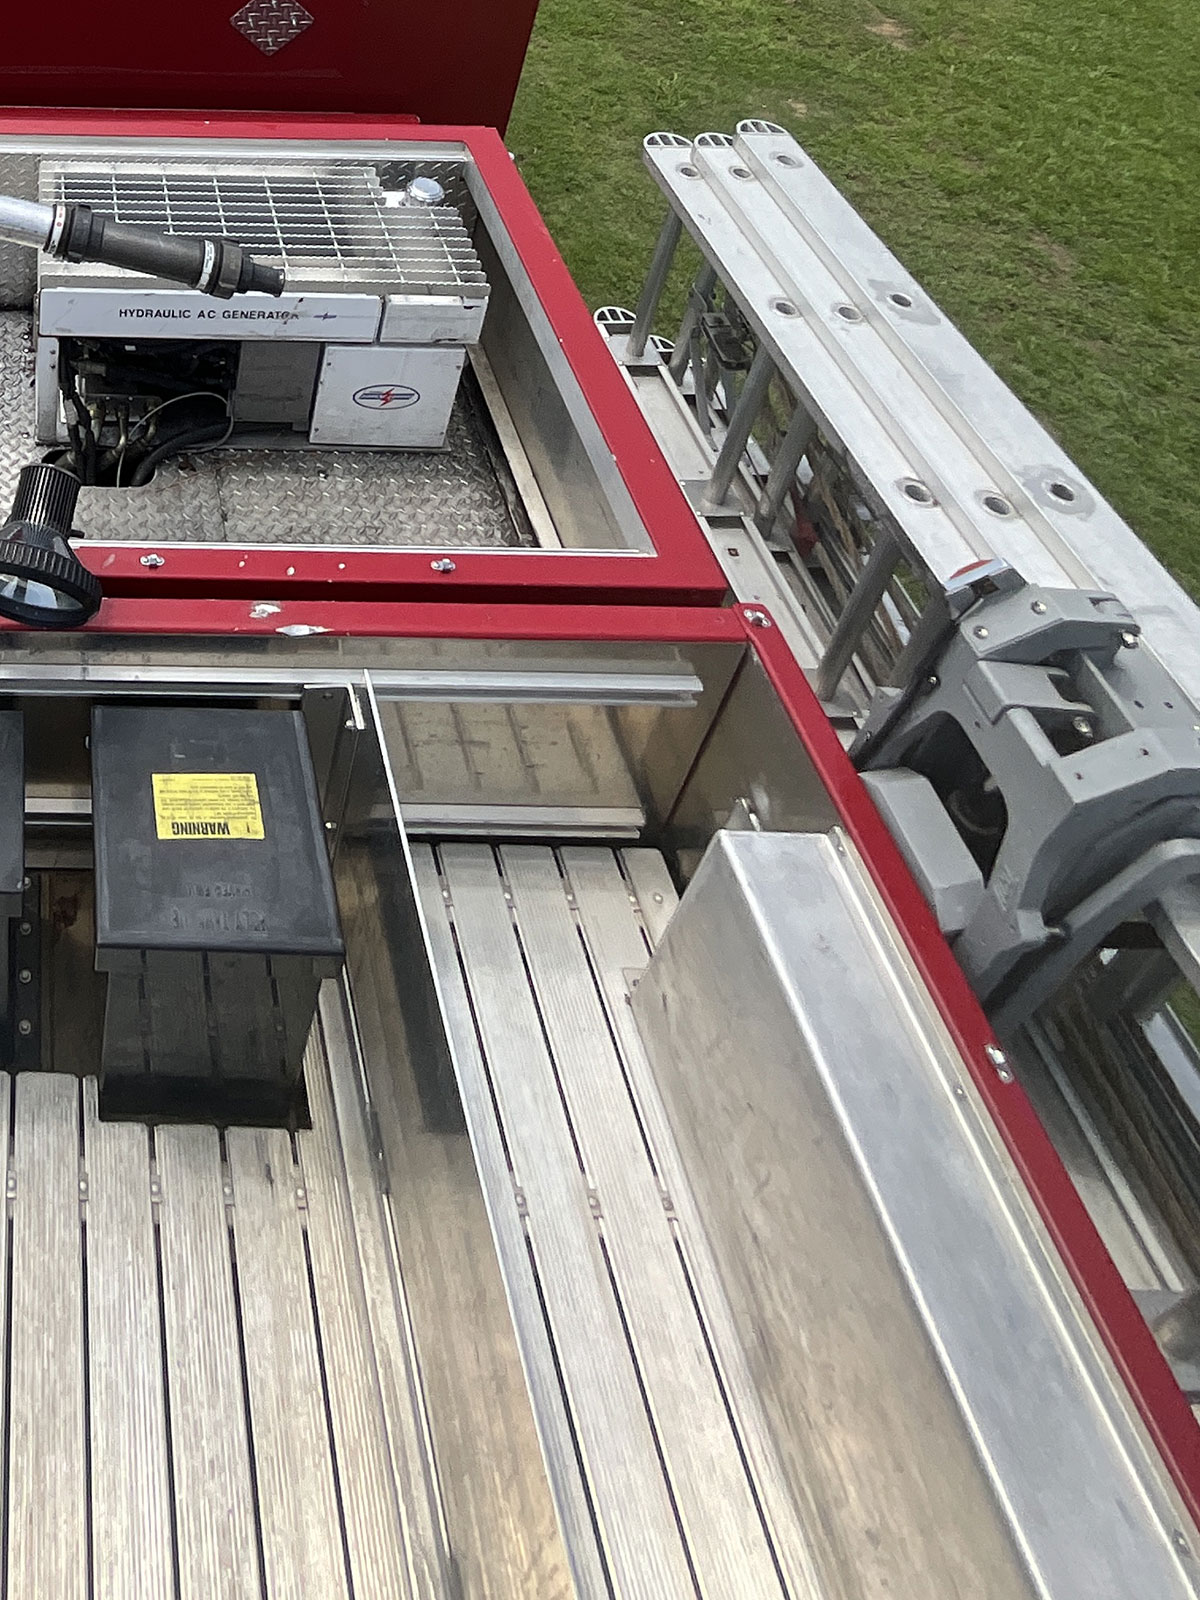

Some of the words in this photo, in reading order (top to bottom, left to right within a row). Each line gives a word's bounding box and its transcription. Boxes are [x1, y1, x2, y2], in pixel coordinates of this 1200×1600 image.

[119, 308, 191, 319] HYDRAULIC
[197, 309, 216, 319] AC
[222, 310, 299, 320] GENERATOR
[171, 821, 231, 836] WARNING
